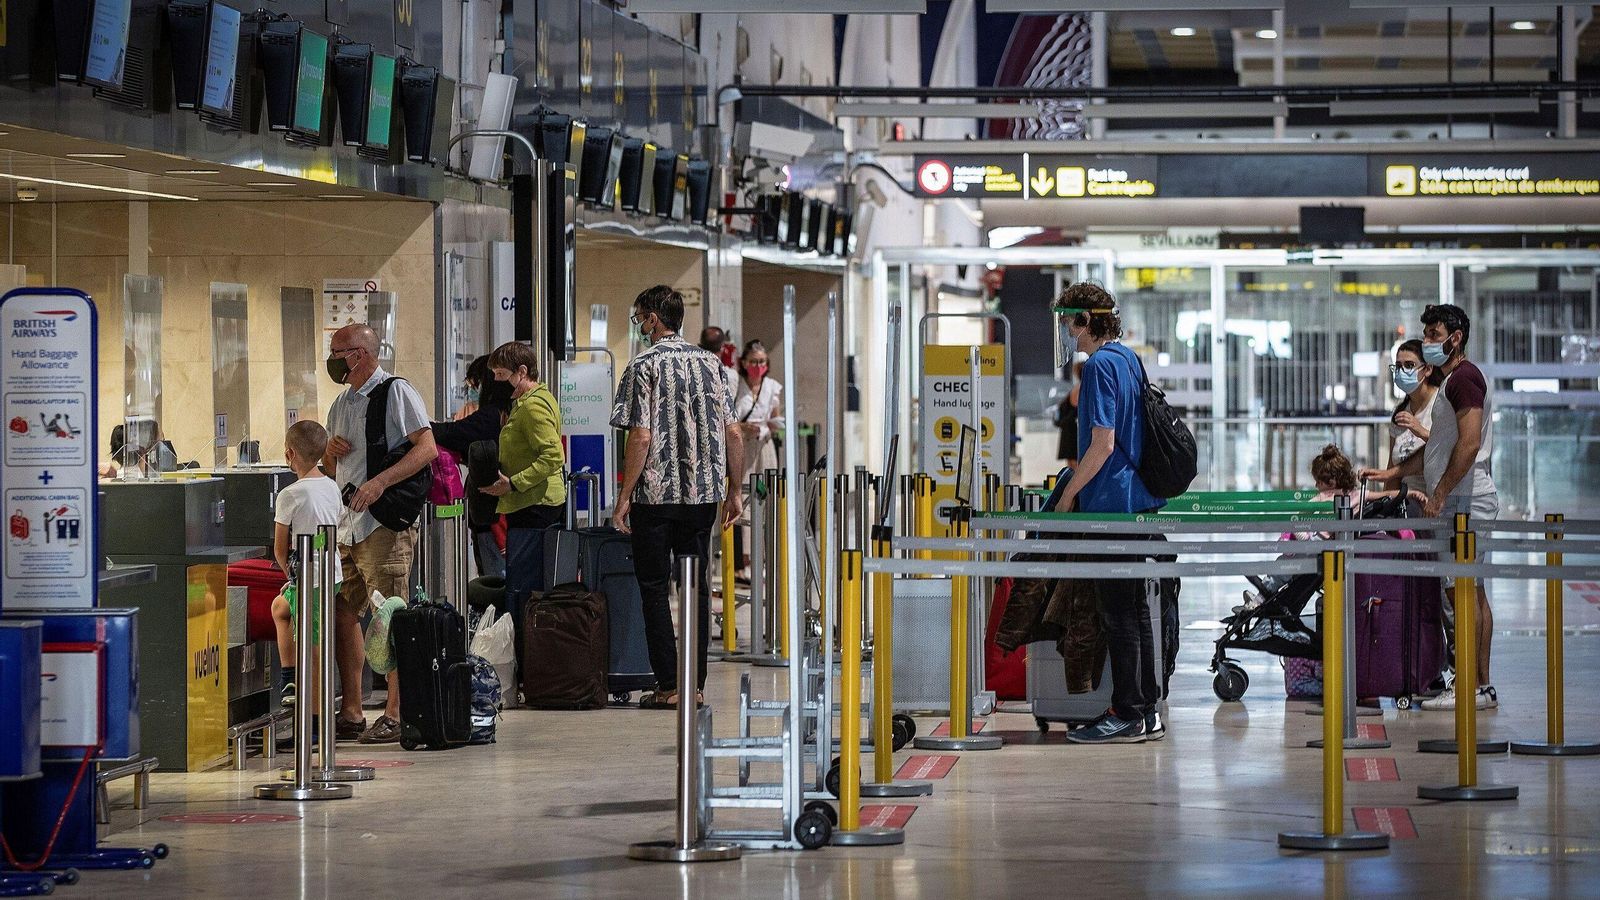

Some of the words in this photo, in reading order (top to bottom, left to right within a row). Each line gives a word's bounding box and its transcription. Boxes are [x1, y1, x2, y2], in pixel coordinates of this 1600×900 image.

[1420, 166, 1442, 182] Only
[1442, 166, 1463, 180] with
[1463, 166, 1506, 182] boarding
[1506, 166, 1530, 180] card
[1449, 180, 1473, 194] con
[1473, 179, 1518, 196] tarjeta
[1518, 180, 1535, 194] de
[1535, 178, 1600, 196] embarque
[501, 297, 516, 311] CA
[13, 319, 57, 329] BRITISH
[11, 329, 58, 338] AIRWAYS
[11, 349, 38, 359] Hand
[39, 349, 79, 361] Baggage
[20, 360, 70, 370] Allowance
[933, 381, 970, 393] CHEC
[560, 394, 603, 402] seamos
[933, 399, 957, 408] Hand
[194, 631, 220, 688] vueling
